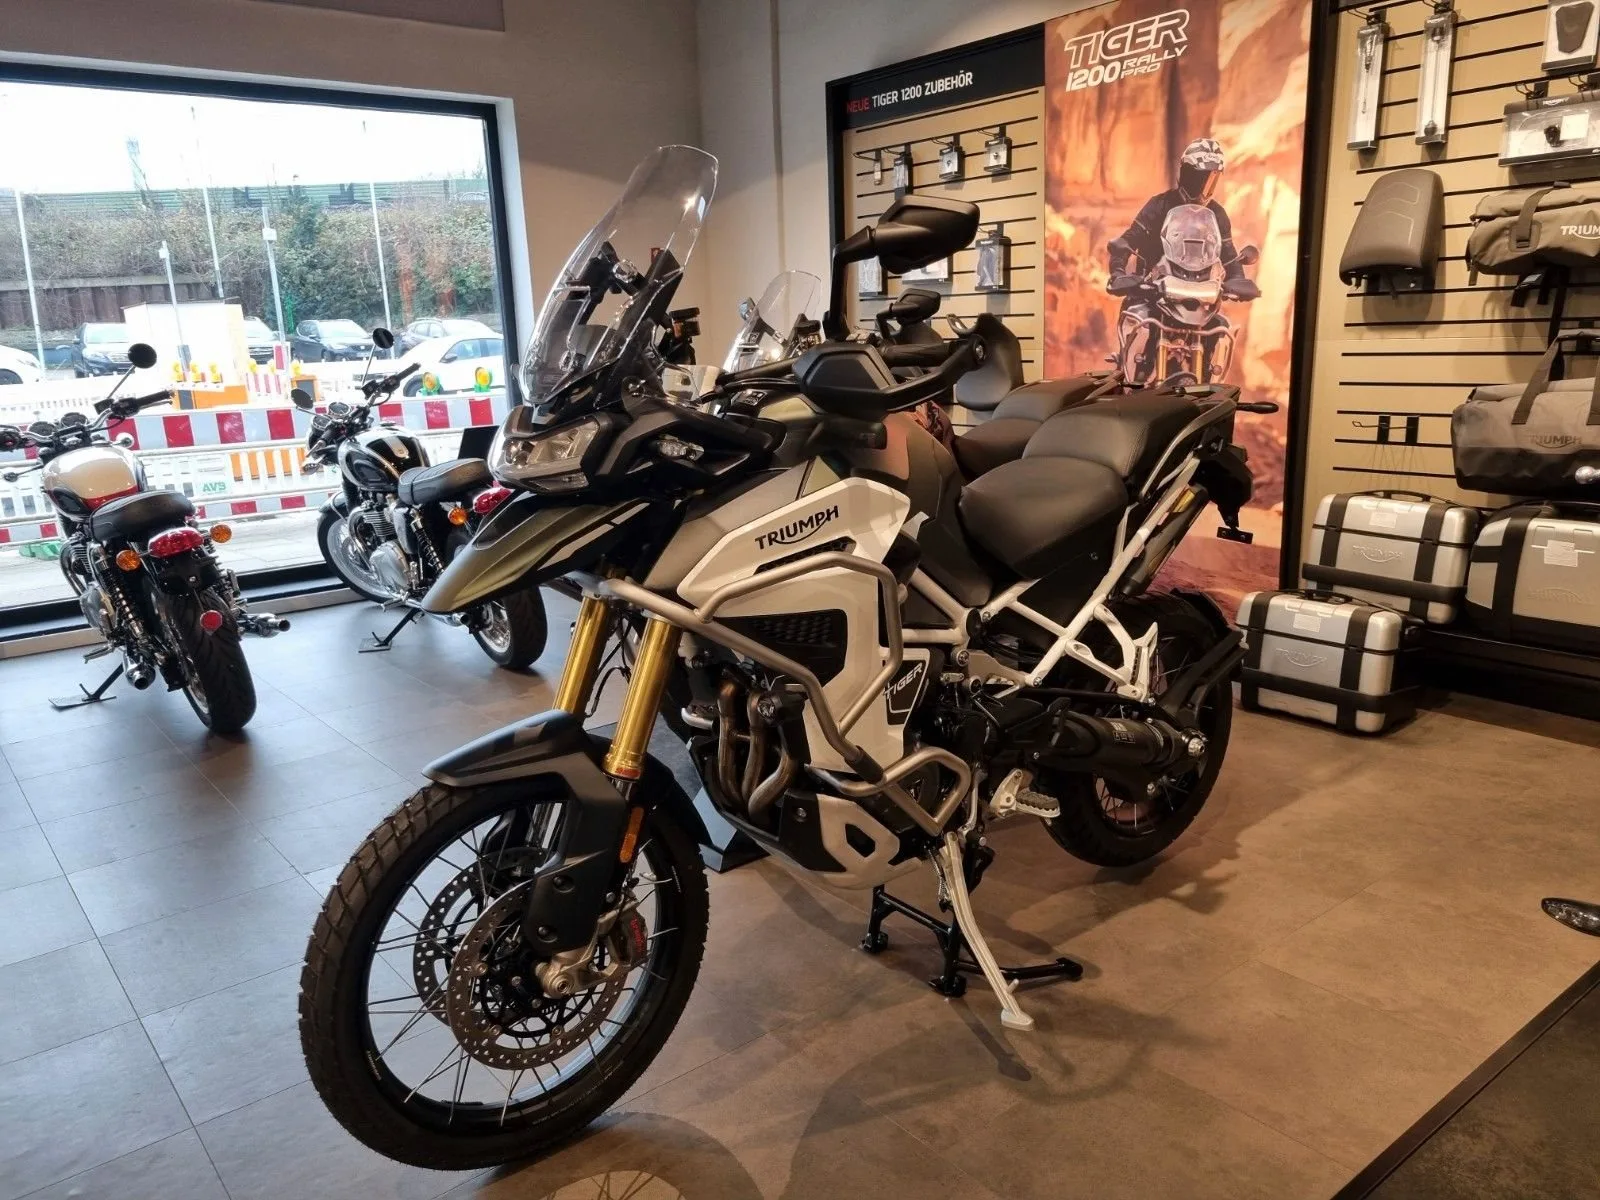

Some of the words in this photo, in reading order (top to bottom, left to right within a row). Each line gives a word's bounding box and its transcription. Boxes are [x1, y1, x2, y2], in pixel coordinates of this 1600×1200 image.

[1064, 9, 1190, 69] TIGER
[1065, 60, 1121, 92] 1200
[1122, 44, 1188, 70] RALLY
[1120, 62, 1161, 79] PRO
[847, 97, 870, 113] NEUE
[872, 90, 899, 108] TIGER
[901, 84, 923, 101] 1200
[924, 70, 974, 96] ZUBEHÖR
[755, 505, 839, 550] TRIUMPH
[883, 662, 923, 700] TIGER
